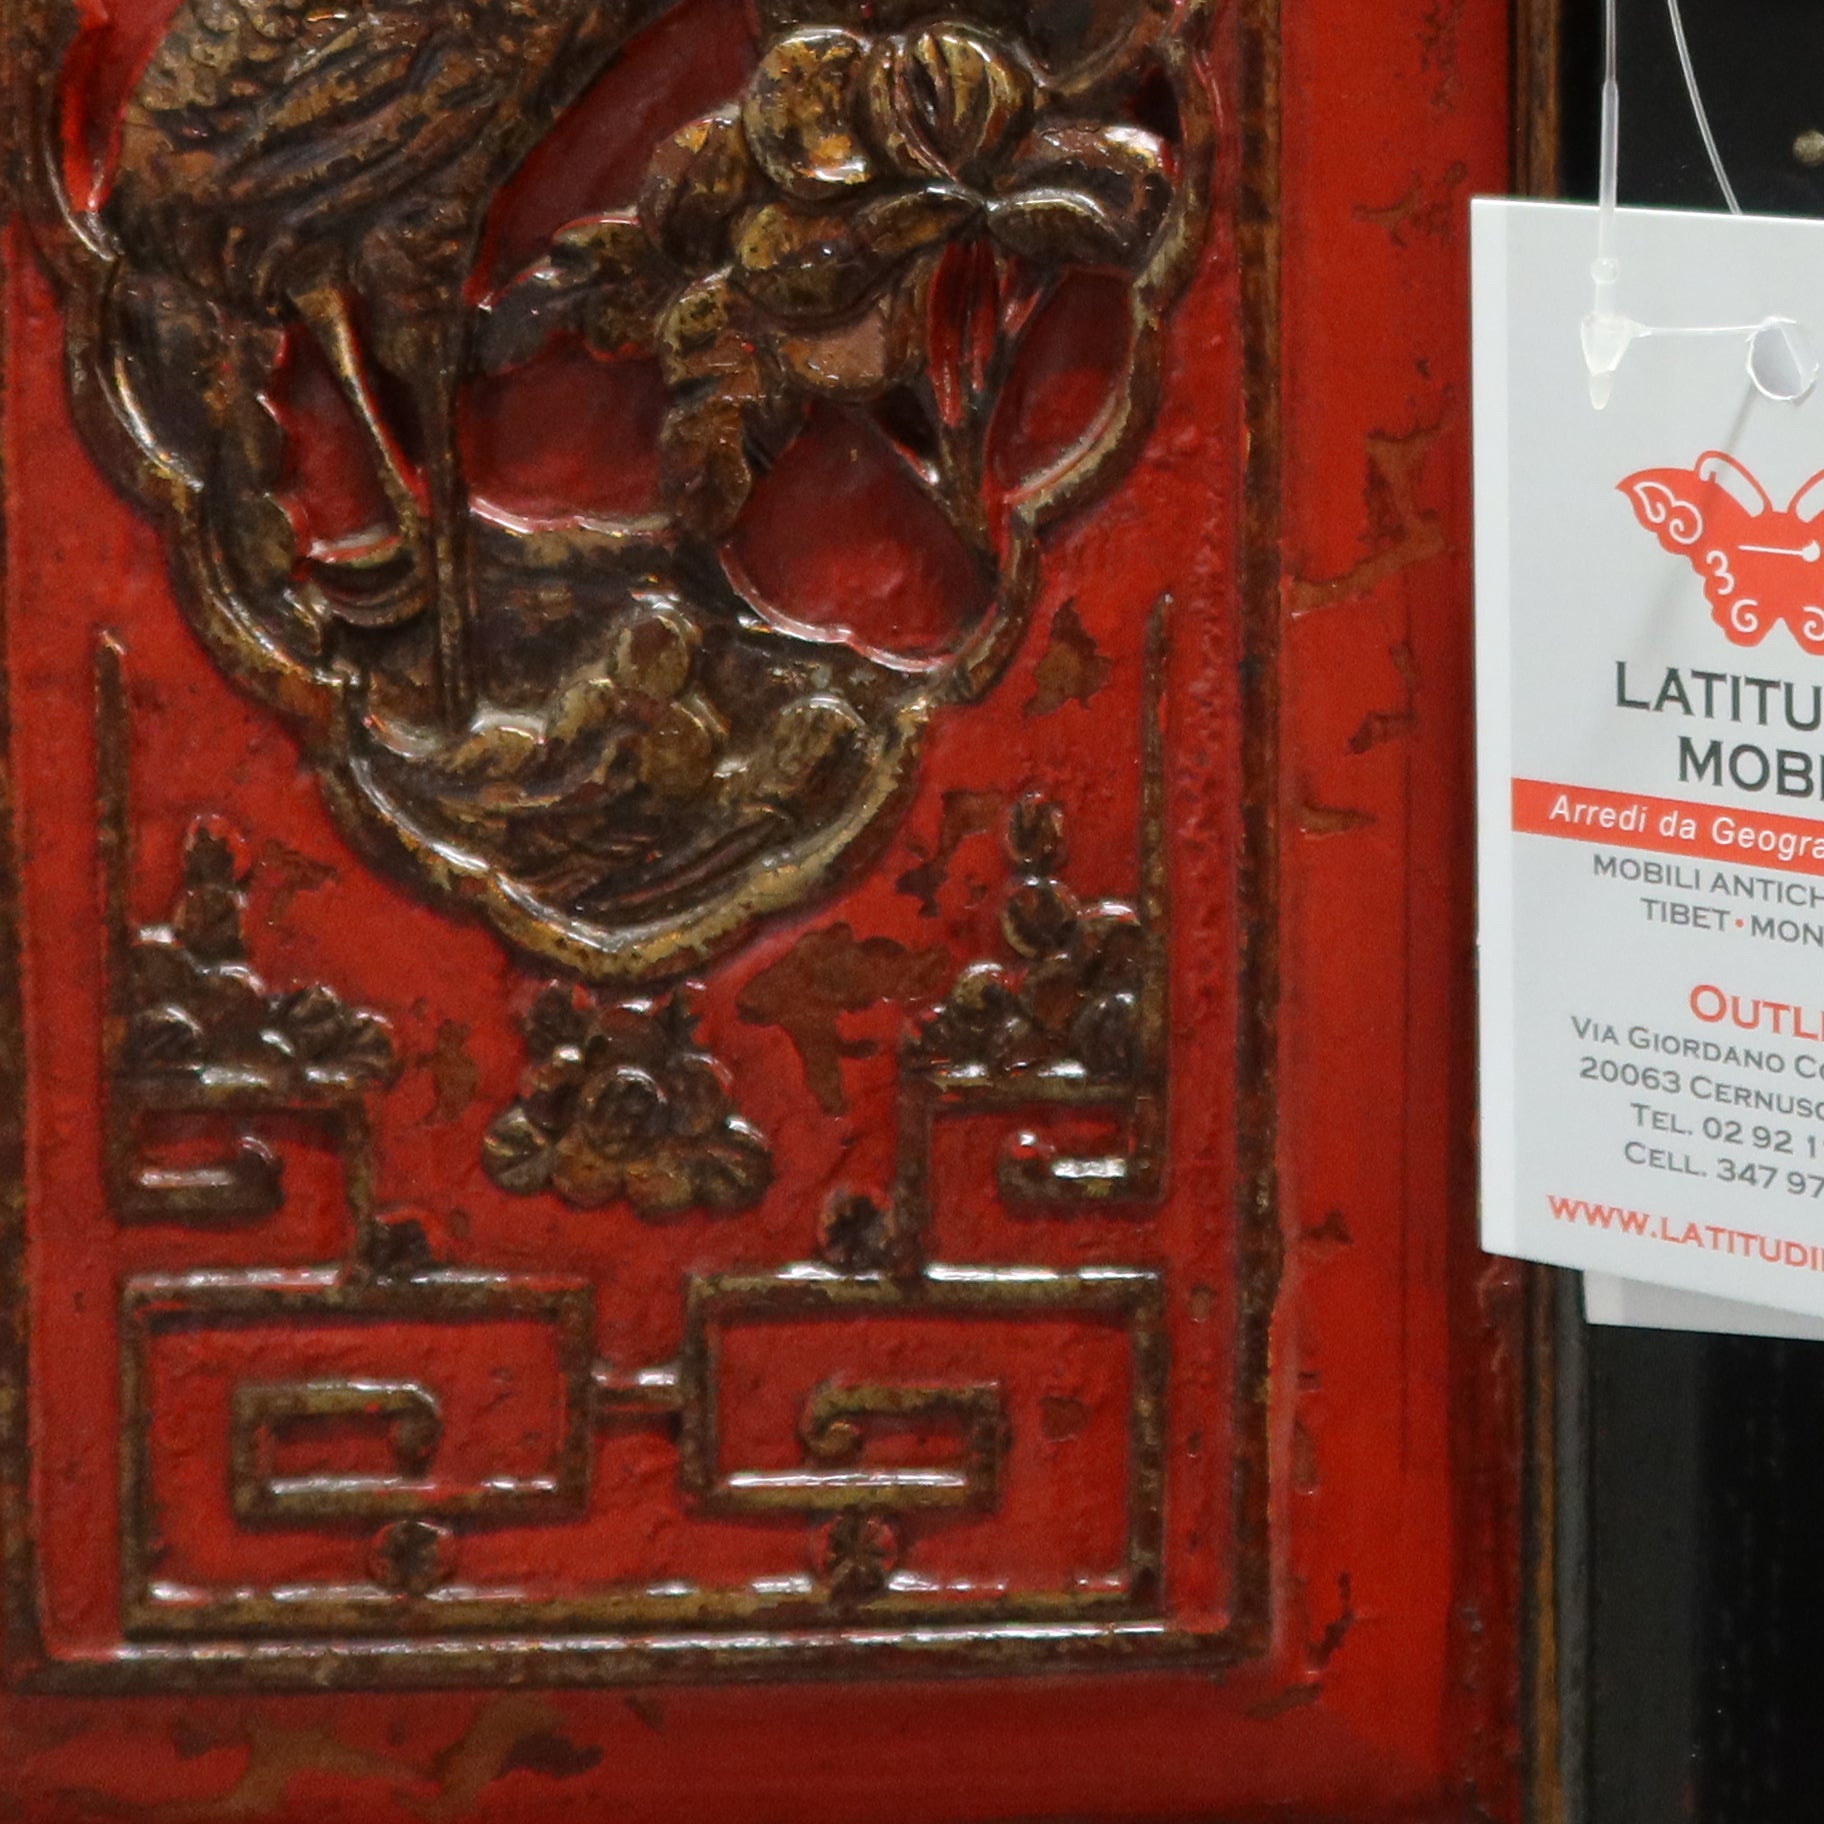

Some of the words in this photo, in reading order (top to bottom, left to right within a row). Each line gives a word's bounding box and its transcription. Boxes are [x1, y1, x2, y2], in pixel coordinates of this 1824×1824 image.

[1550, 795, 1647, 832] Arredi
[1659, 811, 1697, 839] da
[1594, 854, 1699, 889] MOBILI
[1641, 898, 1730, 931] TIBET
[1572, 1016, 1618, 1044] VIA
[1629, 1026, 1785, 1073] GIORDANO
[1580, 1057, 1680, 1093] 20063
[1631, 1103, 1692, 1135] TEL.
[1703, 1117, 1743, 1144] 02
[1753, 1126, 1793, 1154] 92
[1625, 1142, 1706, 1176] CELL.
[1717, 1158, 1777, 1188] 347
